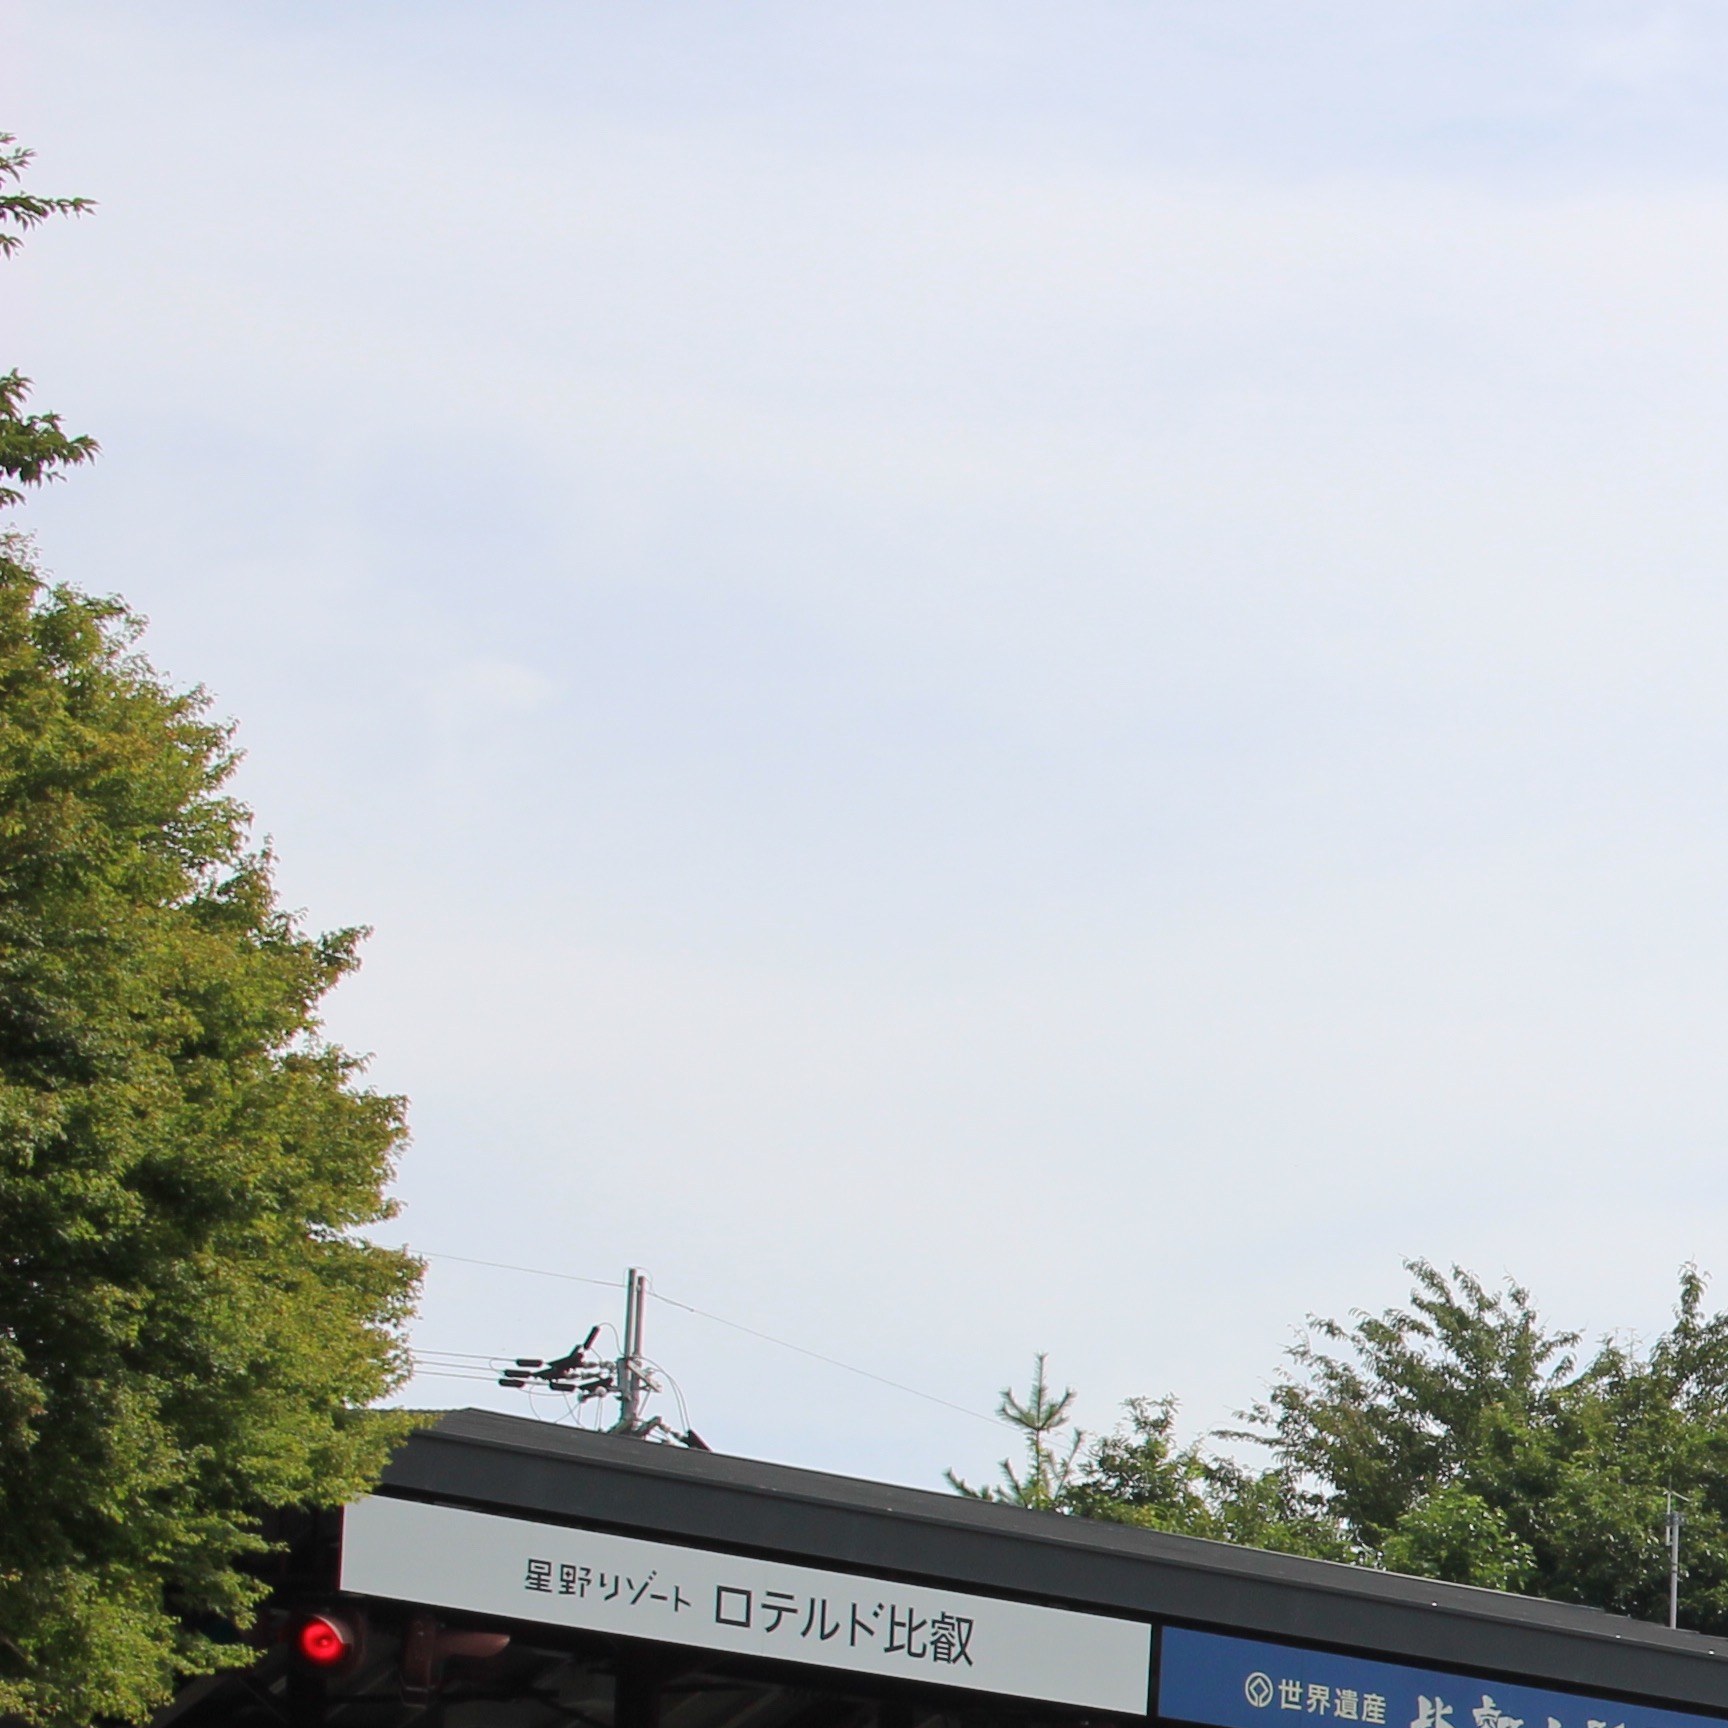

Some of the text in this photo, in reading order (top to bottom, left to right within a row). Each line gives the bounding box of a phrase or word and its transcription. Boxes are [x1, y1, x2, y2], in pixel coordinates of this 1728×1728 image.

[524, 1557, 976, 1668] 星野リゾート ロテルド比叡
[1278, 1678, 1387, 1725] 世界遺産
